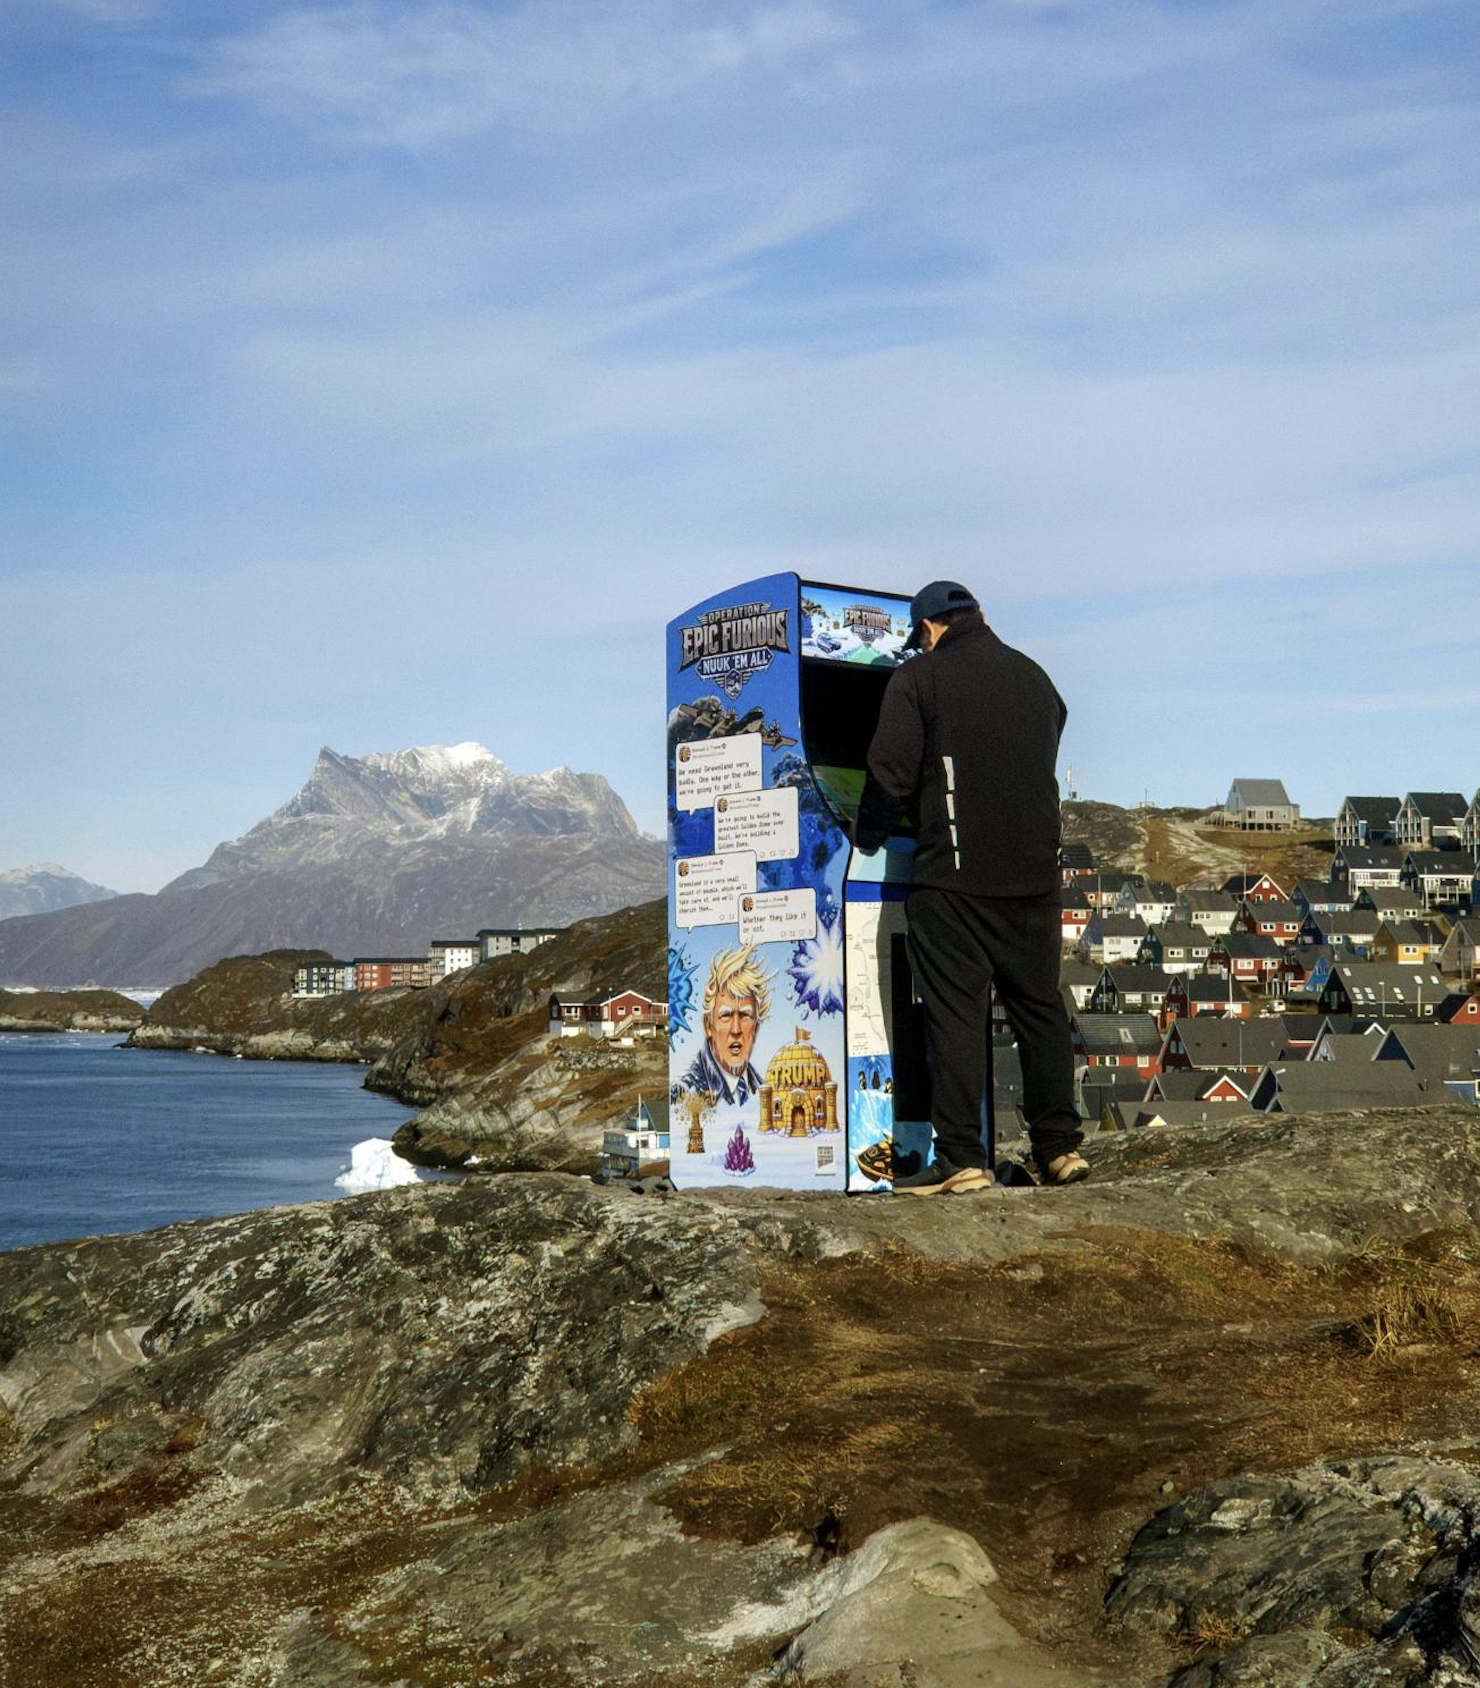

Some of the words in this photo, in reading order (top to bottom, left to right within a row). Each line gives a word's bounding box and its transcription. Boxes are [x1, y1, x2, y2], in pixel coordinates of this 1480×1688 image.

[708, 603, 761, 623] OPERATION
[844, 609, 862, 627] EPIC
[682, 623, 719, 667] EPIC
[721, 610, 787, 652] FURIOUS
[703, 656, 731, 674] NUUK
[732, 653, 749, 669] 'EM
[750, 650, 768, 667] ALL
[688, 767, 701, 775] need
[704, 763, 733, 773] Greenland
[697, 786, 712, 795] going
[723, 783, 732, 792] get
[699, 776, 709, 784] One
[743, 915, 766, 924] Whether
[769, 914, 783, 922] they
[785, 912, 798, 920] like
[800, 911, 806, 919] it
[772, 1065, 826, 1086] TRUMP
